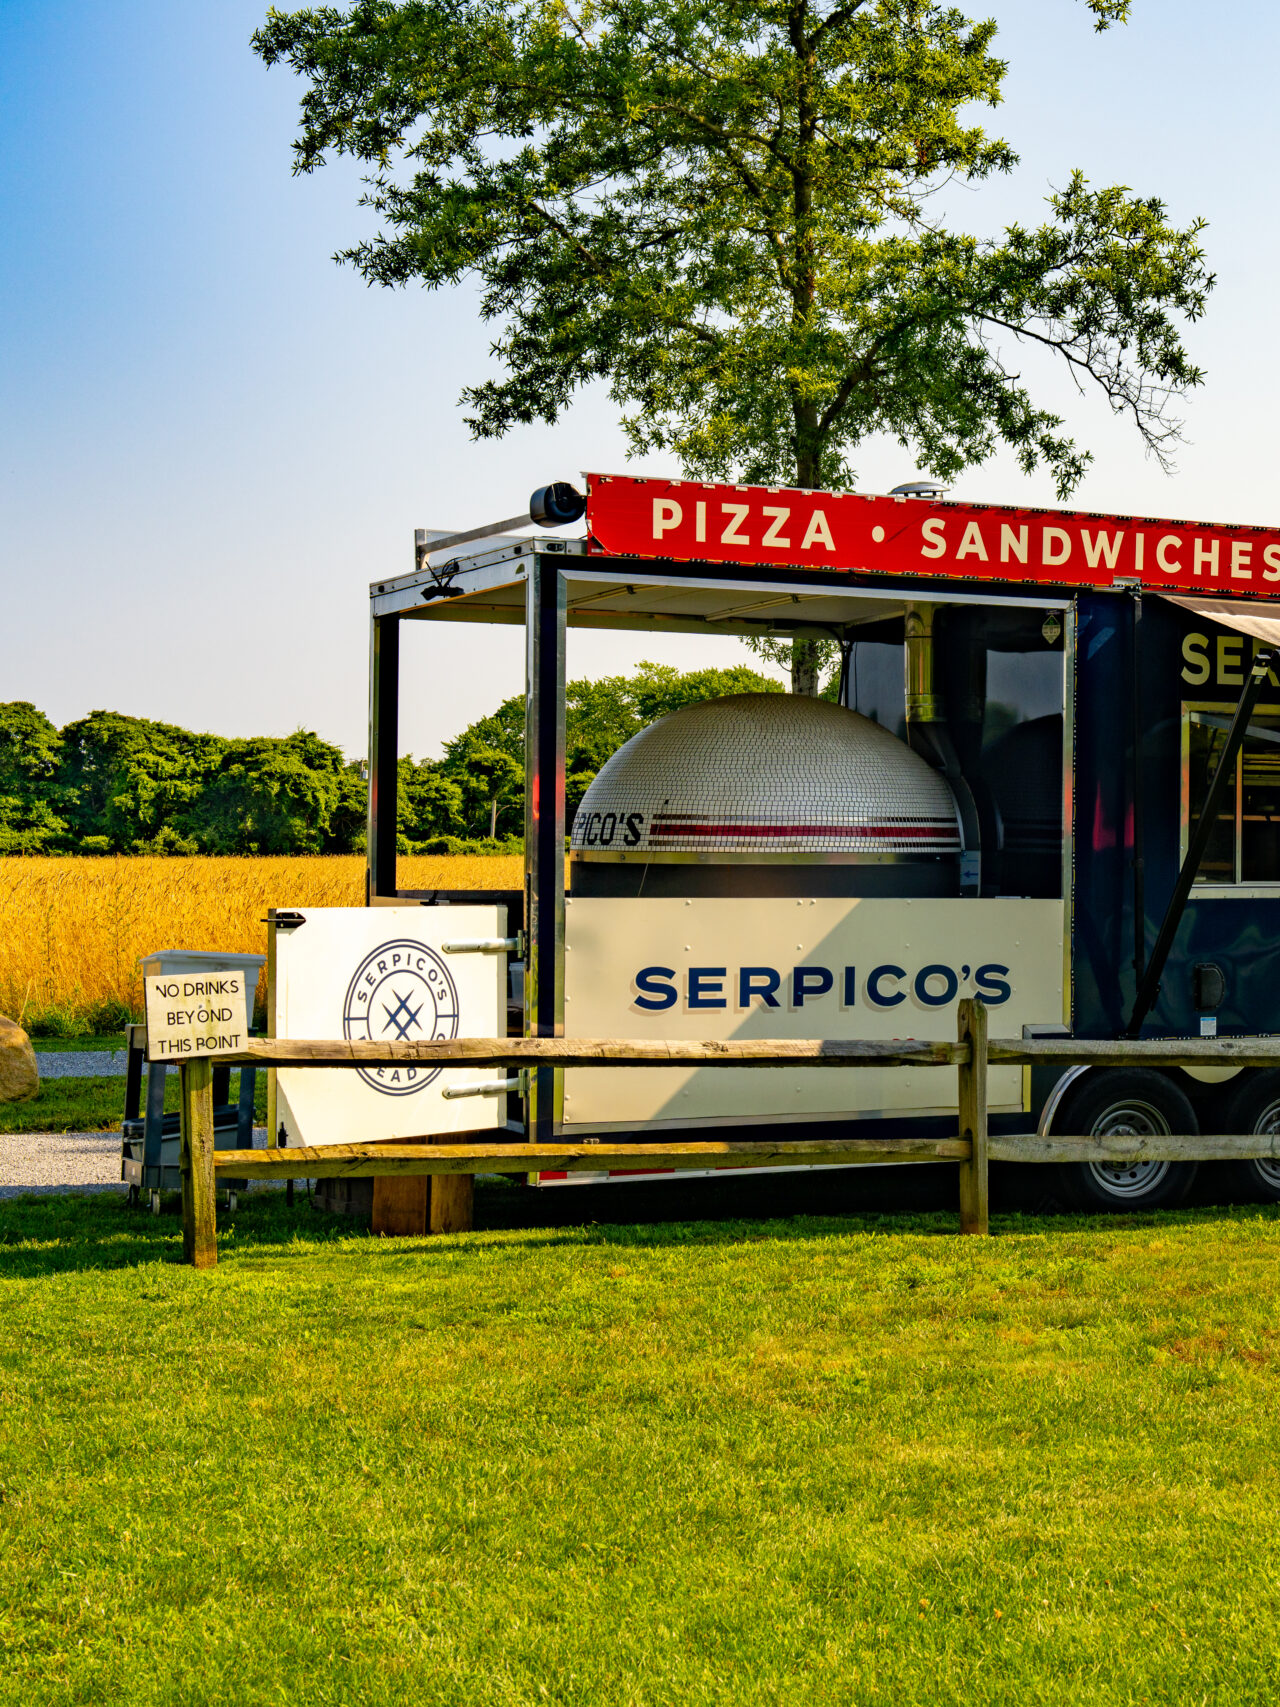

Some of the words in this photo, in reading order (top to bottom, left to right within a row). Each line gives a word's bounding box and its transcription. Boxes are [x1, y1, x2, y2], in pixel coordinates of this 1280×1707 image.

[652, 497, 836, 551] PIZZA
[156, 984, 180, 998] NO
[183, 980, 240, 997] DRINKS
[357, 953, 447, 1003] SERPICO'S
[633, 963, 1013, 1011] SERPICO'S
[167, 1008, 233, 1026] BEYOND
[158, 1039, 192, 1054] THIS
[196, 1035, 241, 1051] POINT
